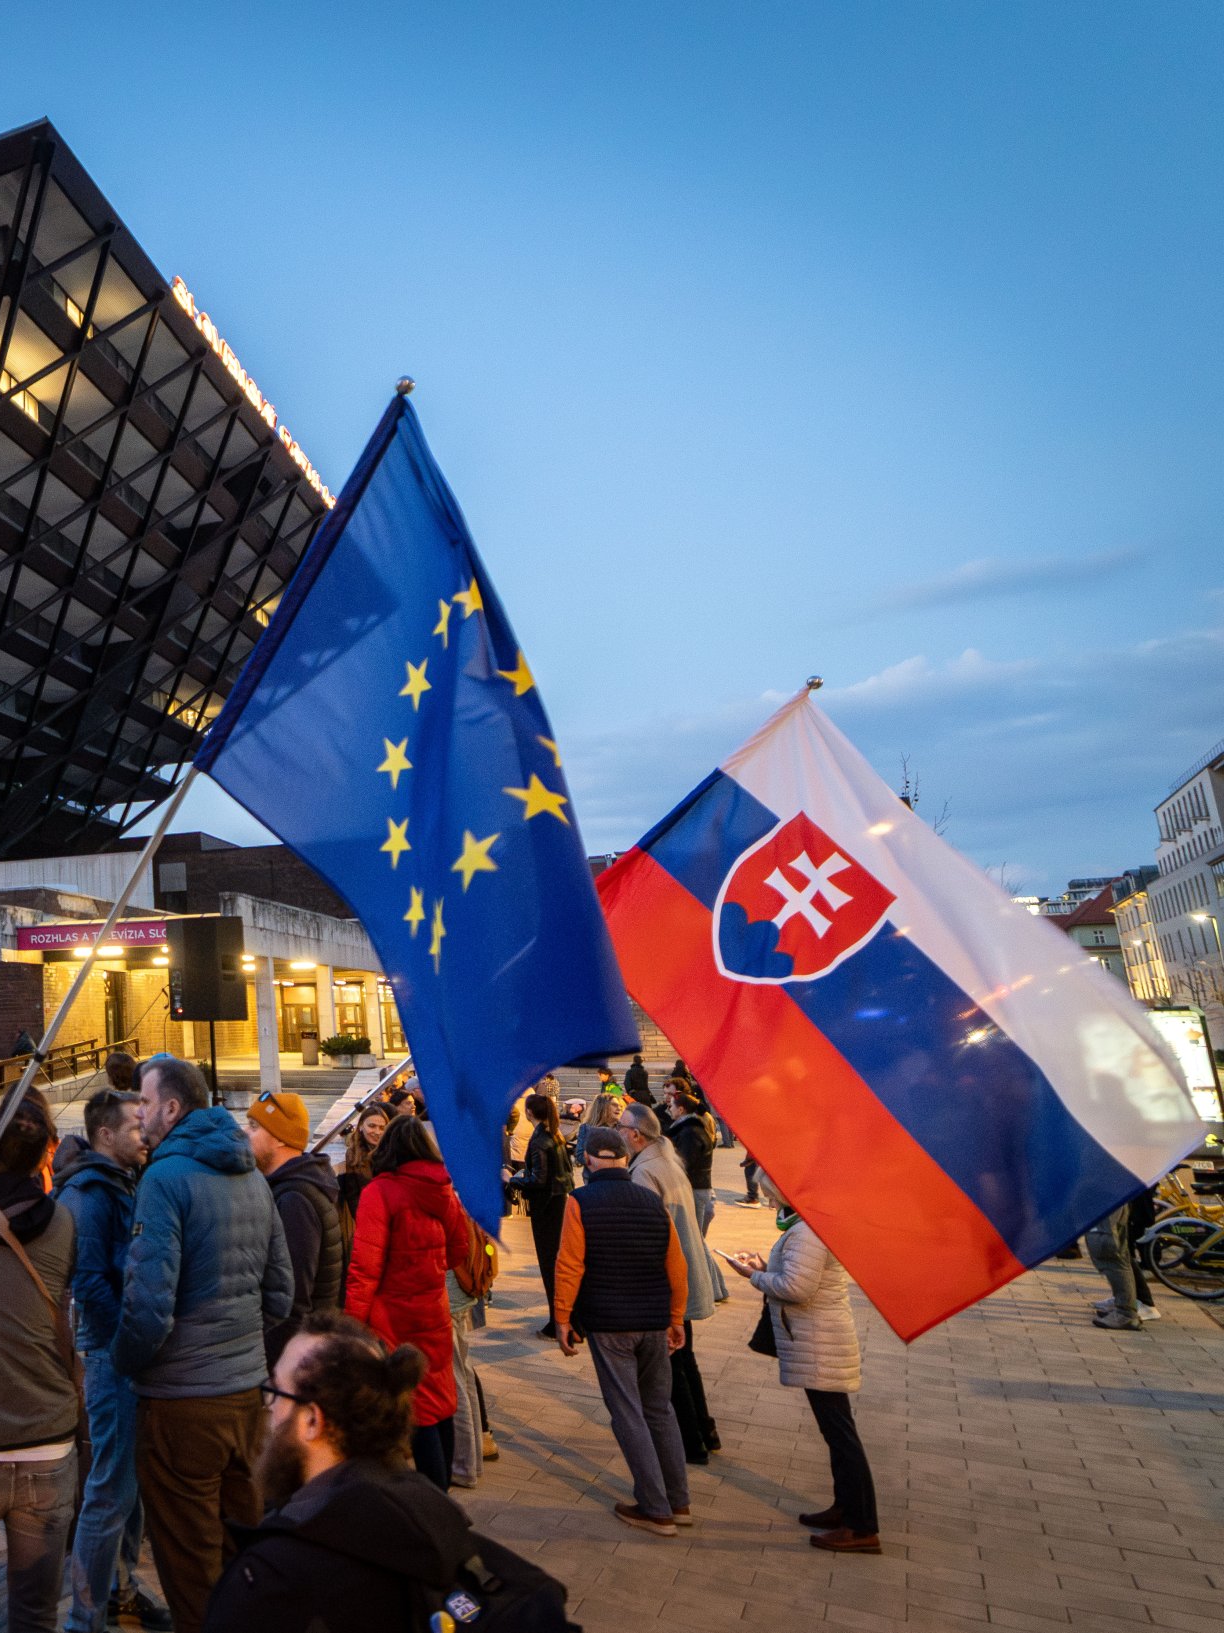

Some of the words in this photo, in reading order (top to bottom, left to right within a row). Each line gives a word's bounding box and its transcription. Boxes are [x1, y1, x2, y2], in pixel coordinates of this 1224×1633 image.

[30, 933, 79, 944] ROZHLAS
[82, 932, 89, 941] A
[92, 928, 145, 941] TEVÍZIA
